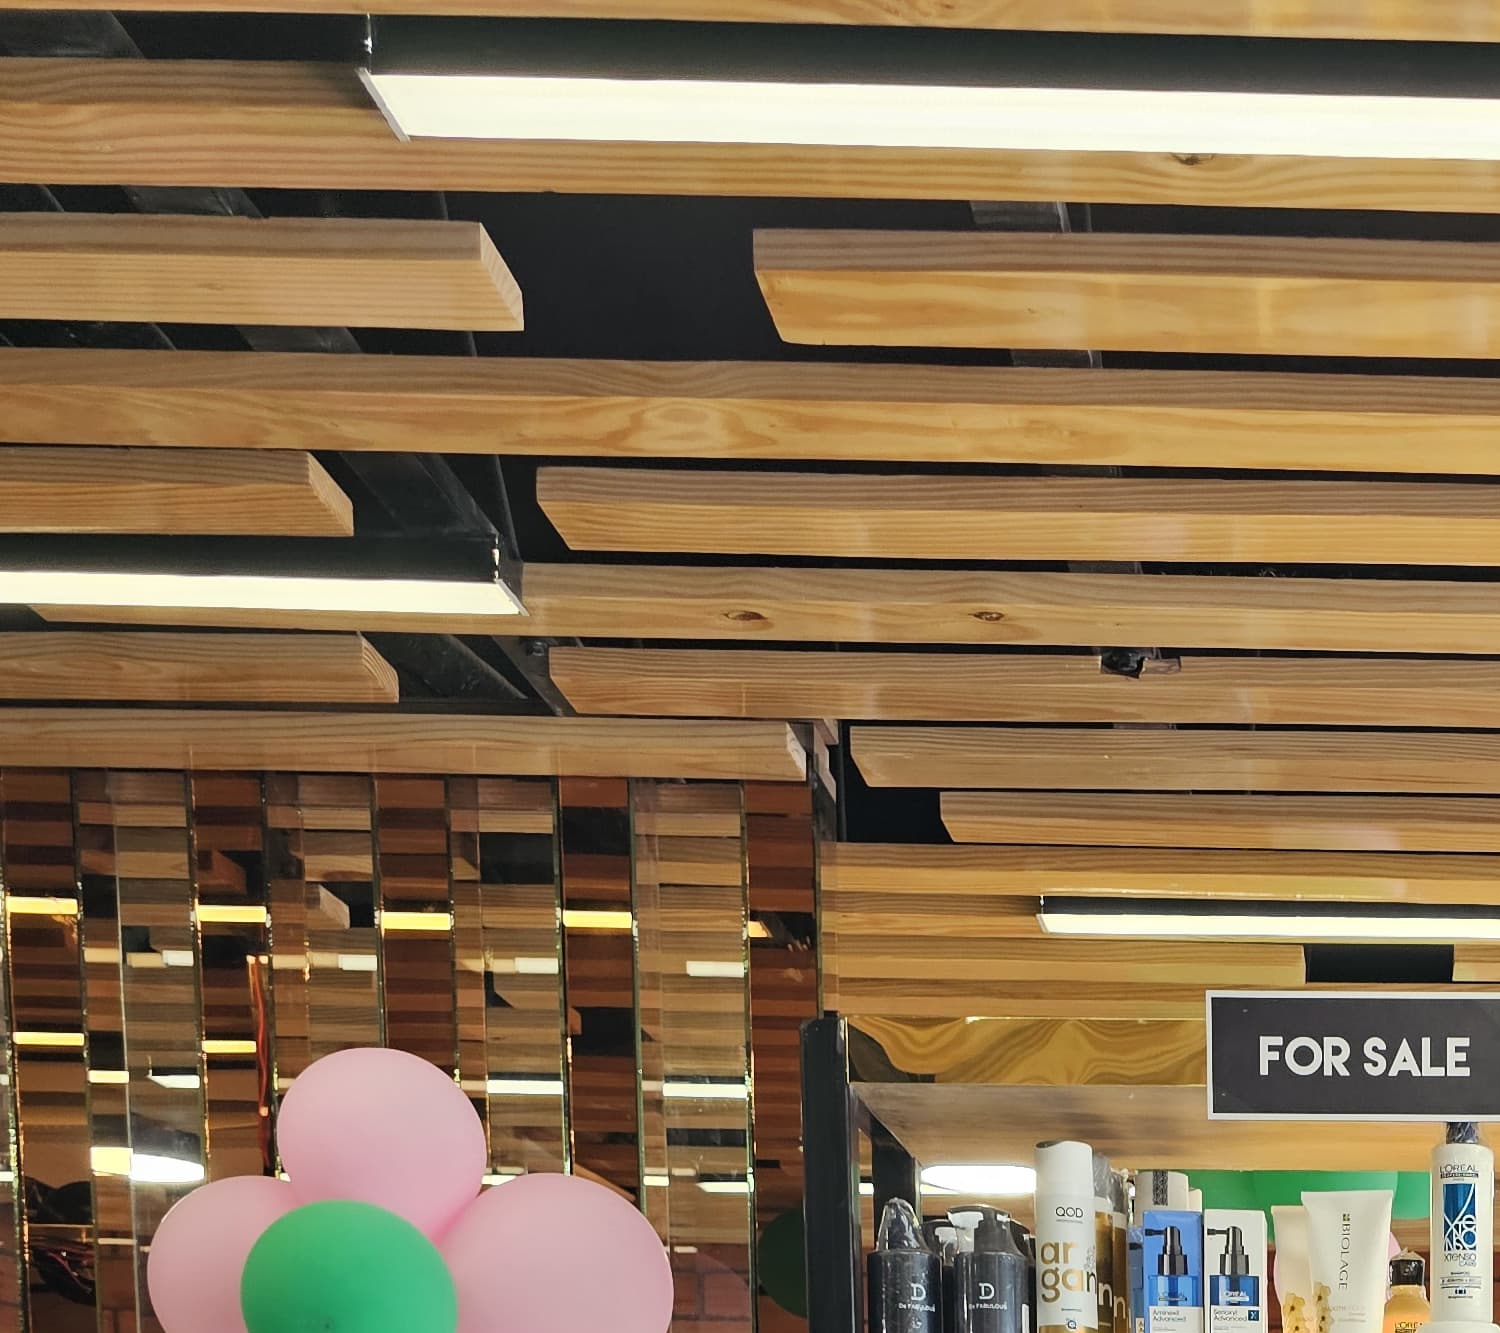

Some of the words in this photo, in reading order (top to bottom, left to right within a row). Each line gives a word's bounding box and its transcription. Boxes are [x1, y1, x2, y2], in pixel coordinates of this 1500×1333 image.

[1259, 1036, 1351, 1076] FOR
[1362, 1036, 1471, 1077] SALE
[1055, 1206, 1084, 1218] QOD
[1338, 1223, 1351, 1290] BIOLAGE
